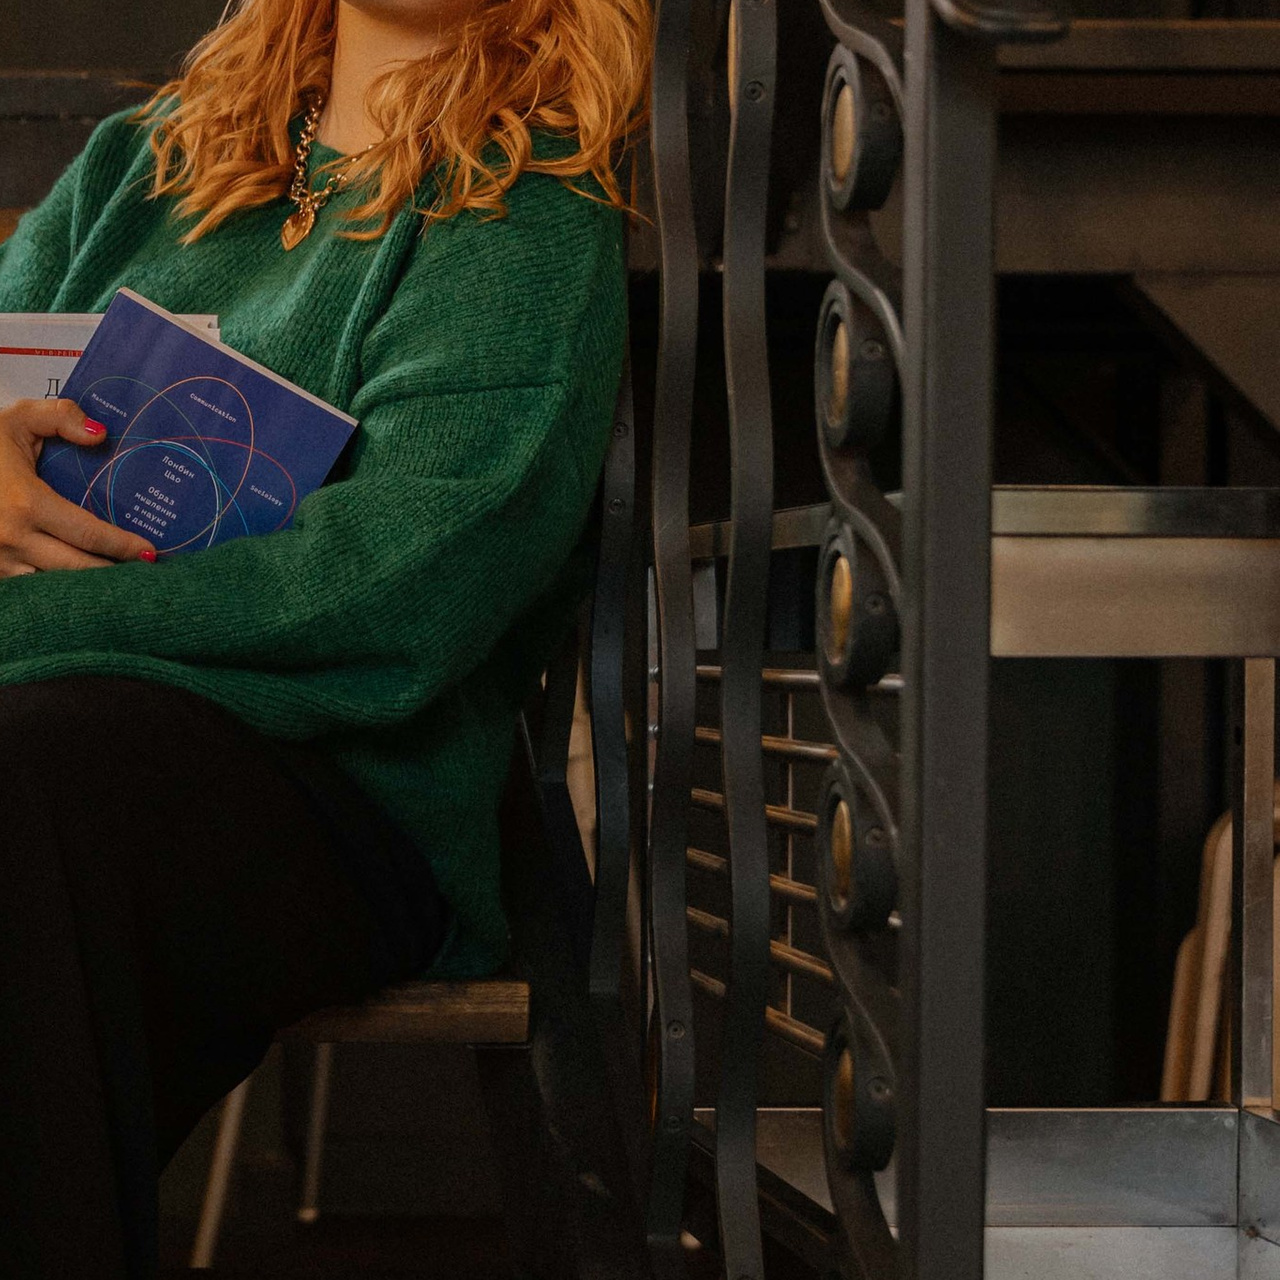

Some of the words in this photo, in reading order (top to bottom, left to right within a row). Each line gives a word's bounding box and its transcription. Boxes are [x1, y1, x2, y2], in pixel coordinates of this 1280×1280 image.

[91, 392, 128, 418] Management
[189, 392, 237, 423] Communication
[162, 455, 195, 478] Лонбин
[164, 470, 181, 483] Цао
[134, 492, 177, 519] мышления
[148, 486, 175, 506] Образ
[249, 484, 284, 507] Sociology
[132, 517, 165, 538] данных
[141, 508, 167, 527] науке
